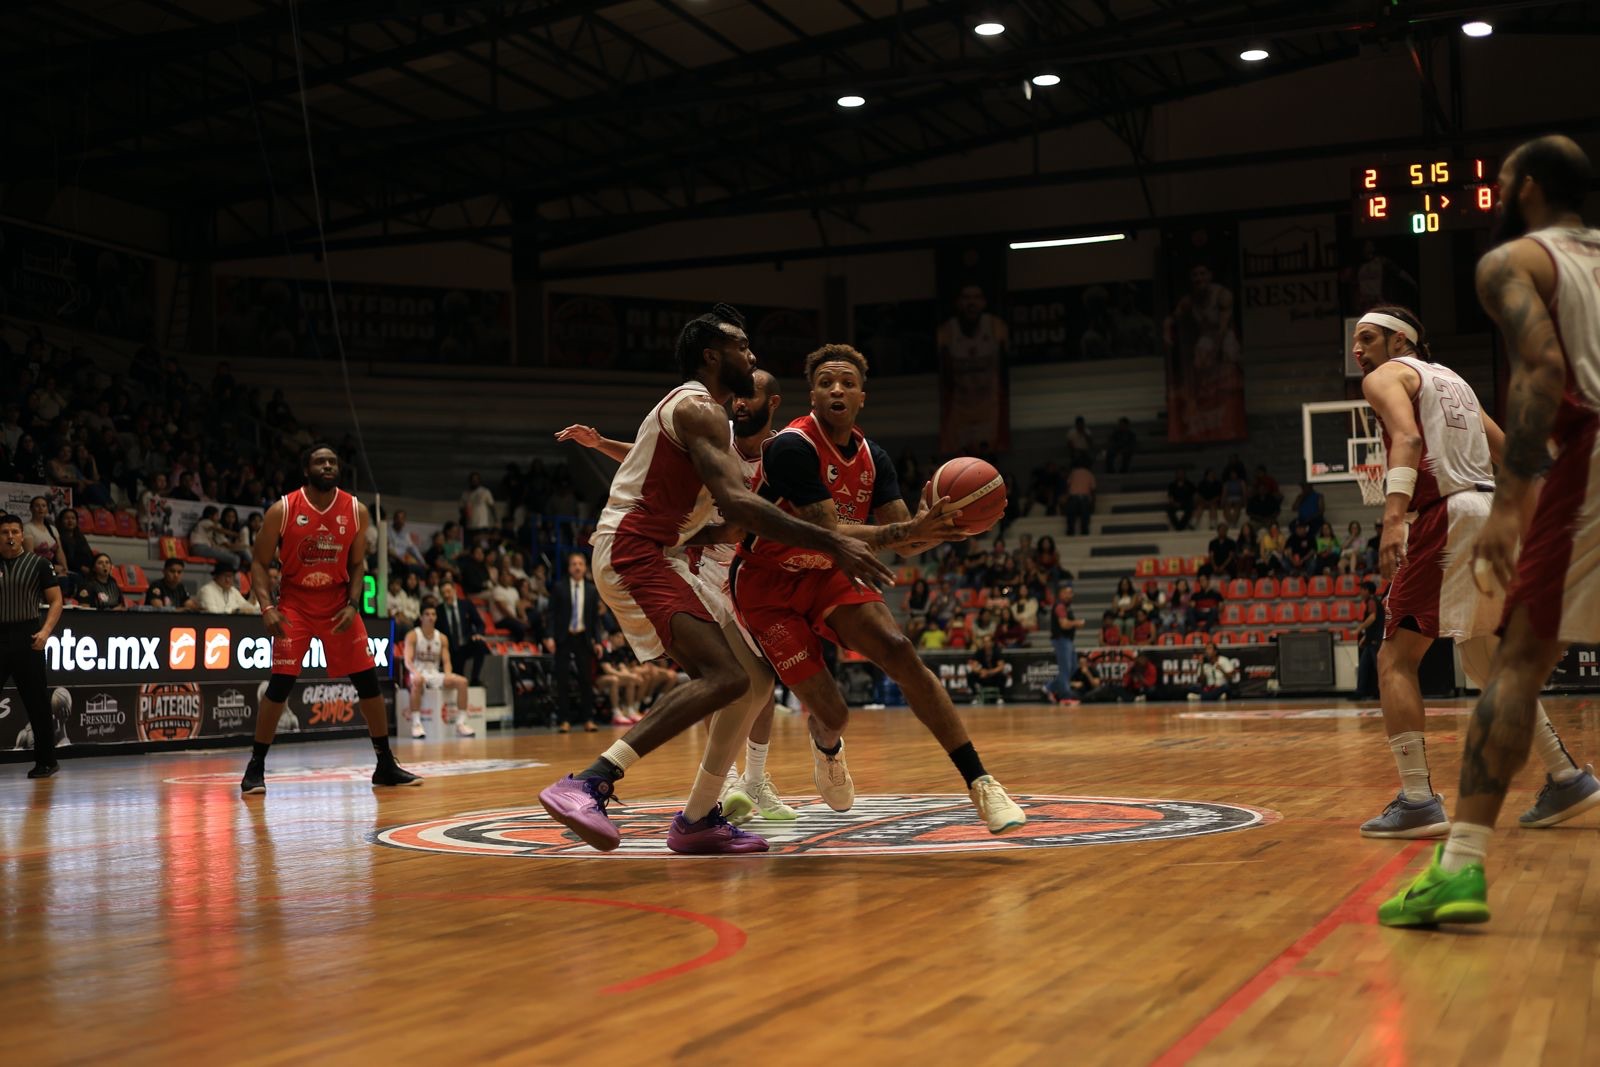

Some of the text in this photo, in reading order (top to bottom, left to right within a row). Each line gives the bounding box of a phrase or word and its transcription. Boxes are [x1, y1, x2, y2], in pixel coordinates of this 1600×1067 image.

[1364, 169, 1377, 188] 2
[1475, 159, 1483, 179] 1
[1368, 187, 1492, 217] 12 1 8
[1412, 212, 1439, 234] 00
[363, 574, 377, 615] 2
[79, 711, 126, 727] FRESNILLO
[139, 694, 200, 721] PLATEROS
[308, 699, 354, 725] SOMOS
